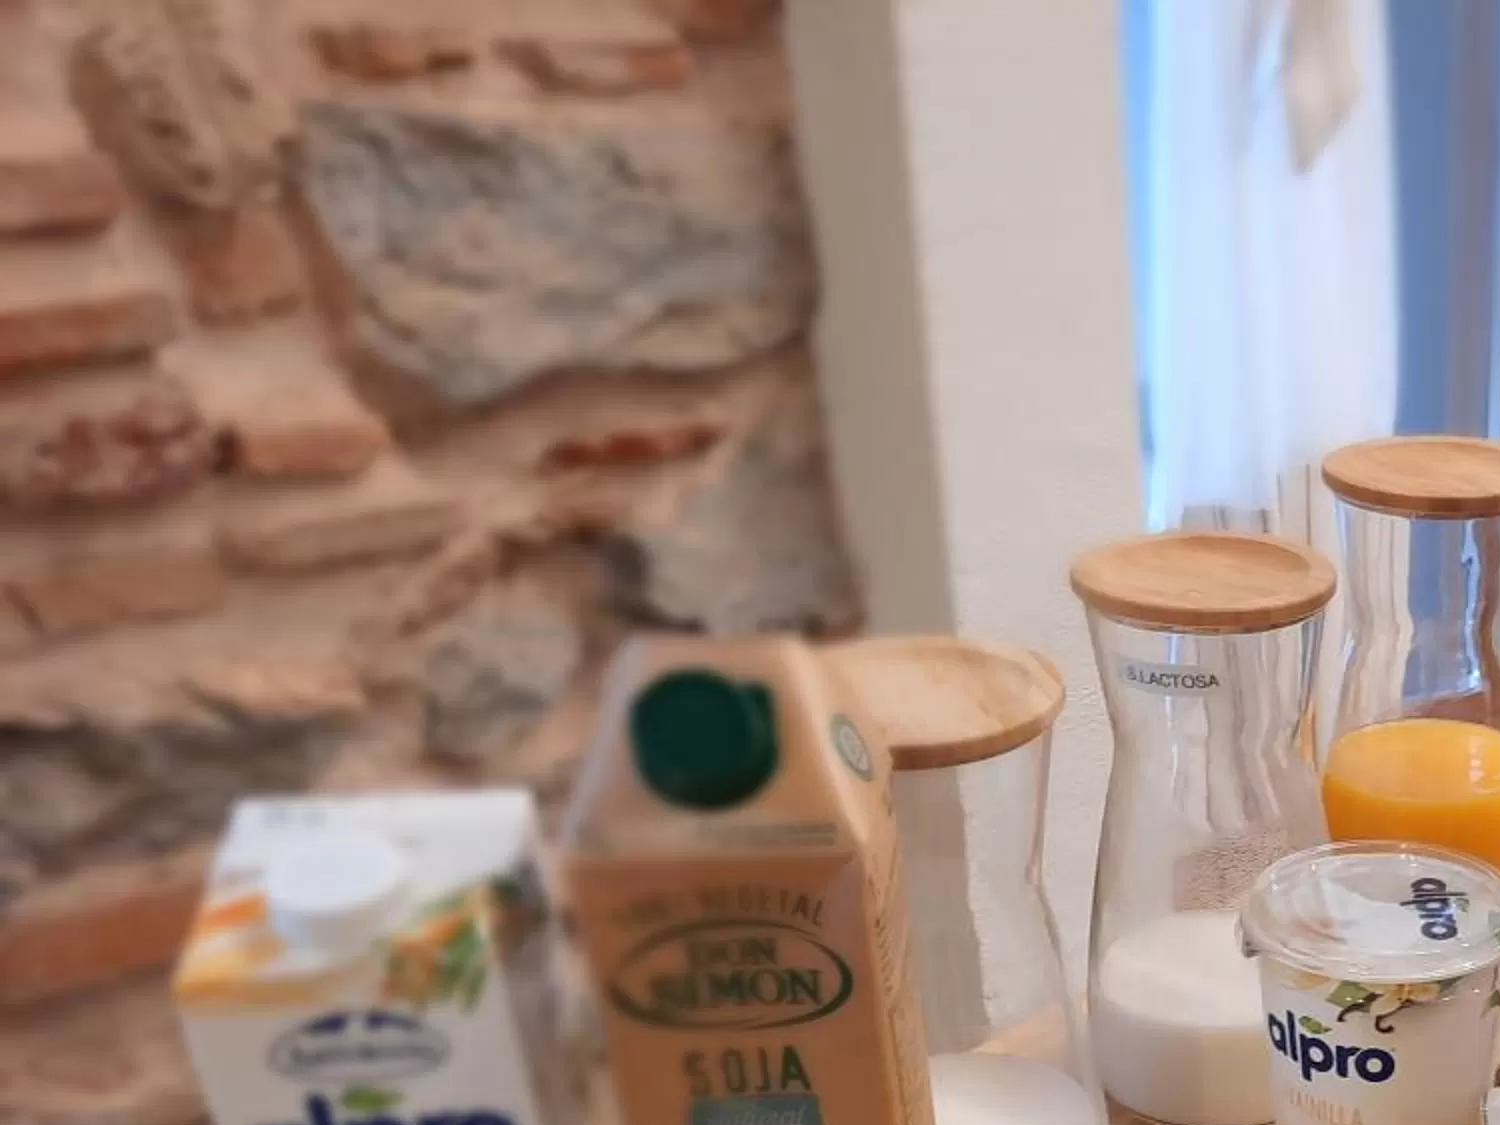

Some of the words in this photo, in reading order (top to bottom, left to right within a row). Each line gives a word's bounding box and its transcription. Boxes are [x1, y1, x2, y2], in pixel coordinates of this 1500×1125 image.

[1399, 877, 1468, 941] alpro
[683, 1045, 811, 1097] SOJA
[1268, 1009, 1396, 1083] alpro
